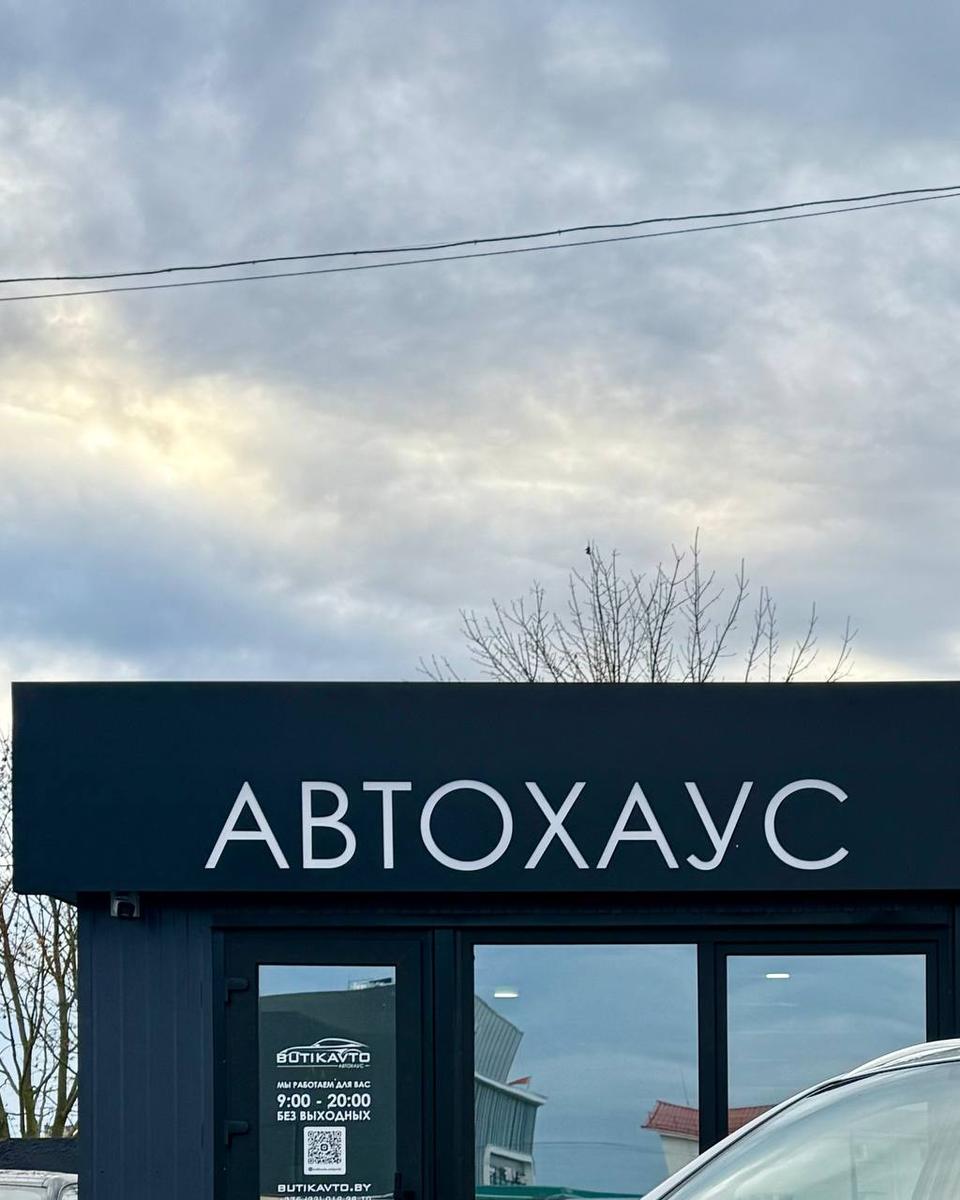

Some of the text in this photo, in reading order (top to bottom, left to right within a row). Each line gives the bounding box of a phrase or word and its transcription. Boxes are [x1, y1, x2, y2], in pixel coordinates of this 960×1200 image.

[205, 779, 850, 872] АВТОХАУС
[276, 1052, 371, 1063] BUTIKAVTO
[336, 1081, 352, 1089] ДЛЯ
[277, 1094, 310, 1108] 9:00
[327, 1093, 371, 1108] 20:00
[277, 1111, 371, 1122] БЕЗ ВЫХОДНЫХ
[277, 1184, 371, 1192] BUTIKAVTO.BY
